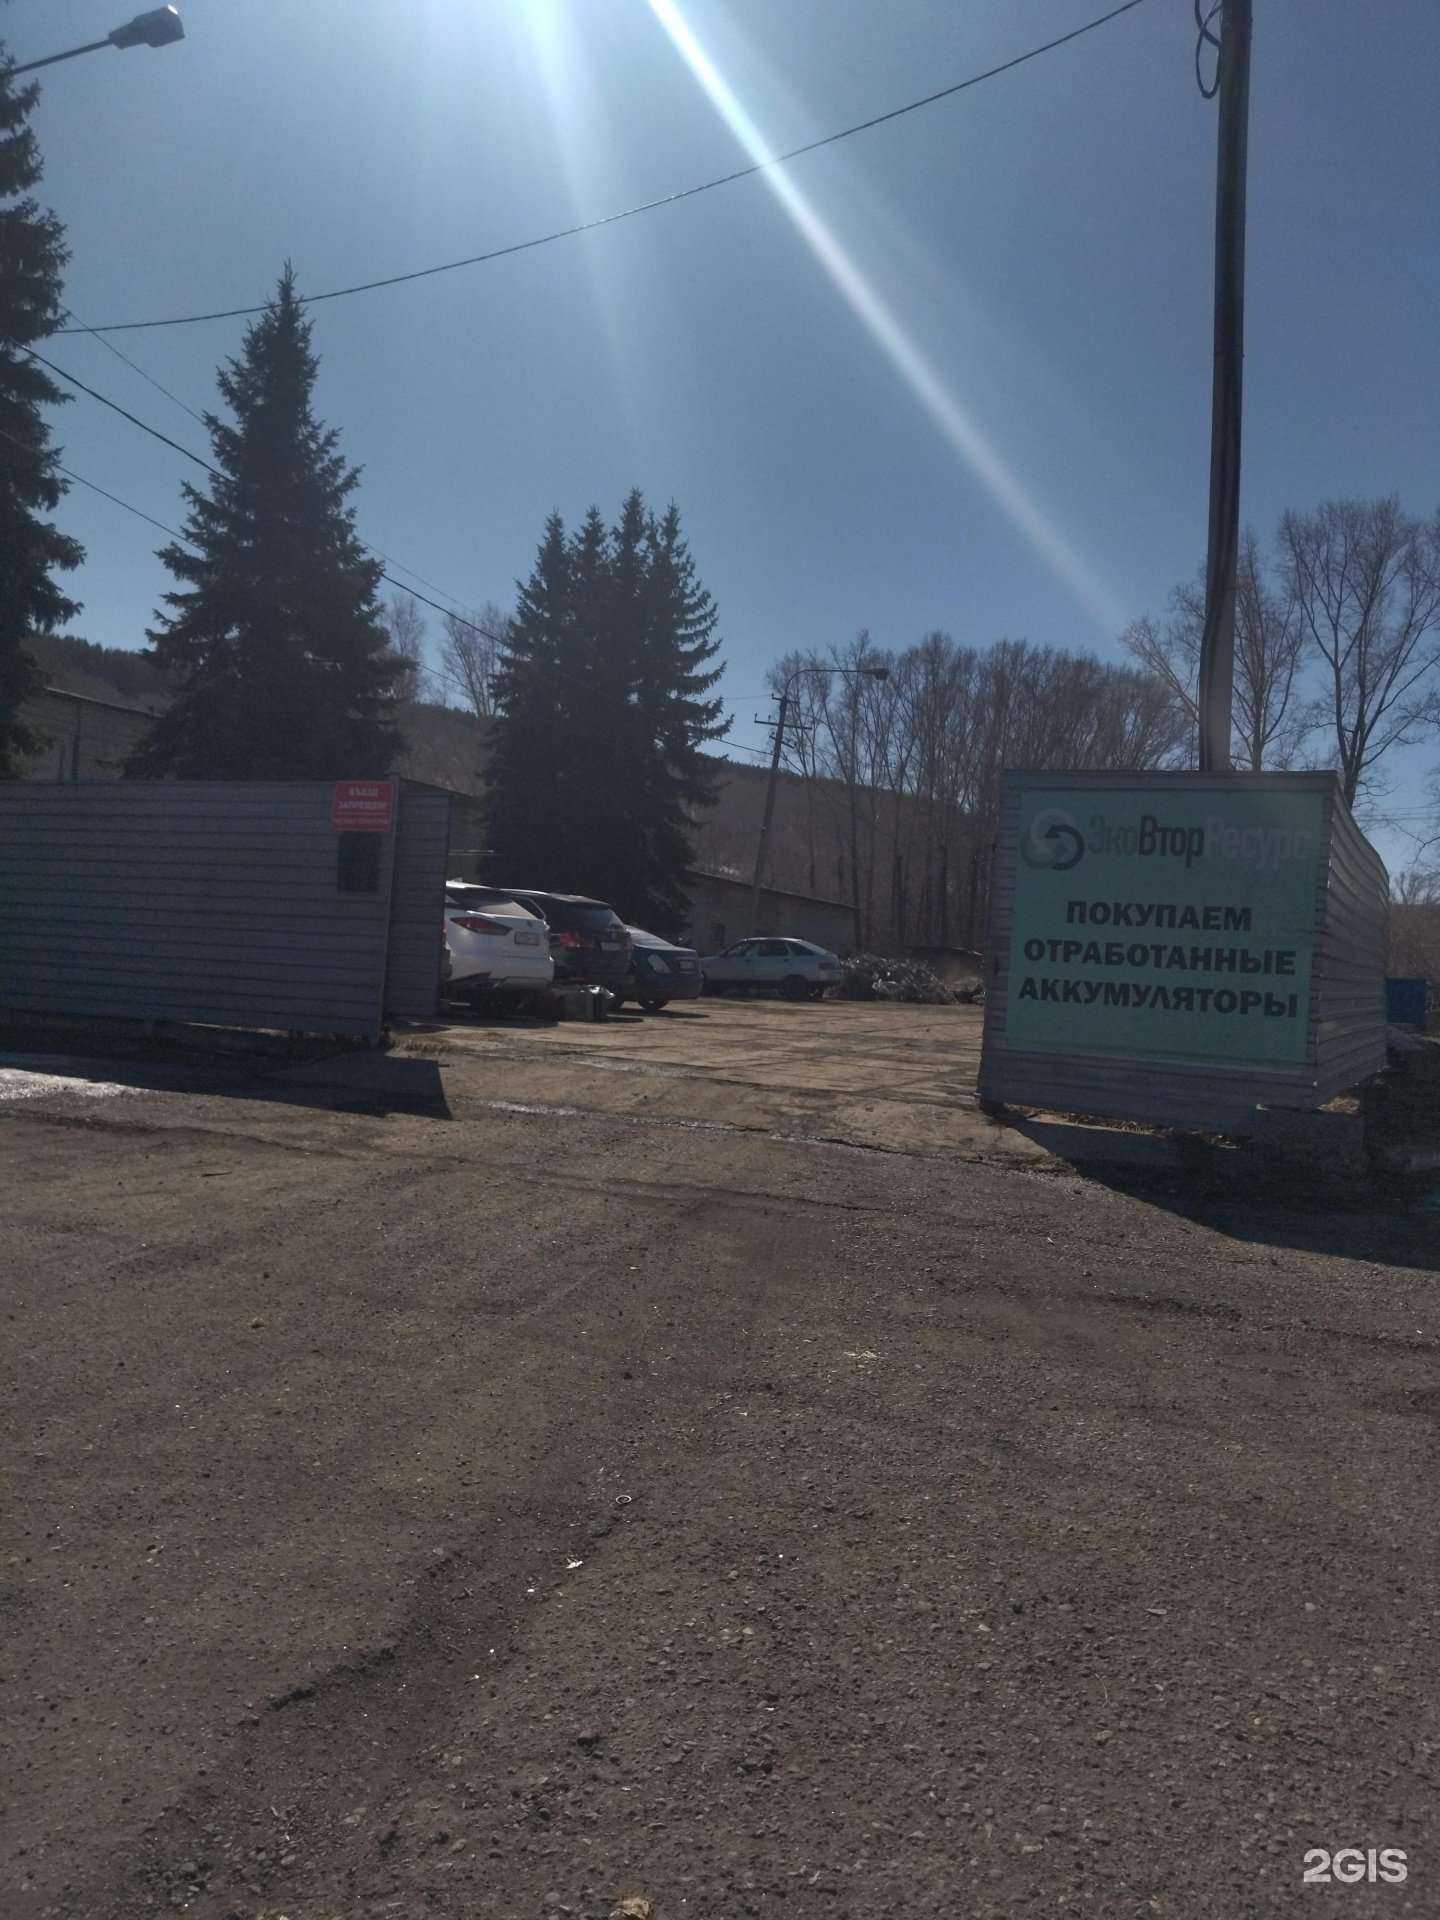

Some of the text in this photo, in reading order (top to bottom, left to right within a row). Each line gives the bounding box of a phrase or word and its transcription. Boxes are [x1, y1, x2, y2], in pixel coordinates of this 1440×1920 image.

[1065, 900, 1252, 931] ПОКУПАЕМ
[1023, 938, 1297, 976] ОТРАБОТАННЫЕ
[1018, 977, 1298, 1018] АККУМУЛЯТОРЫ
